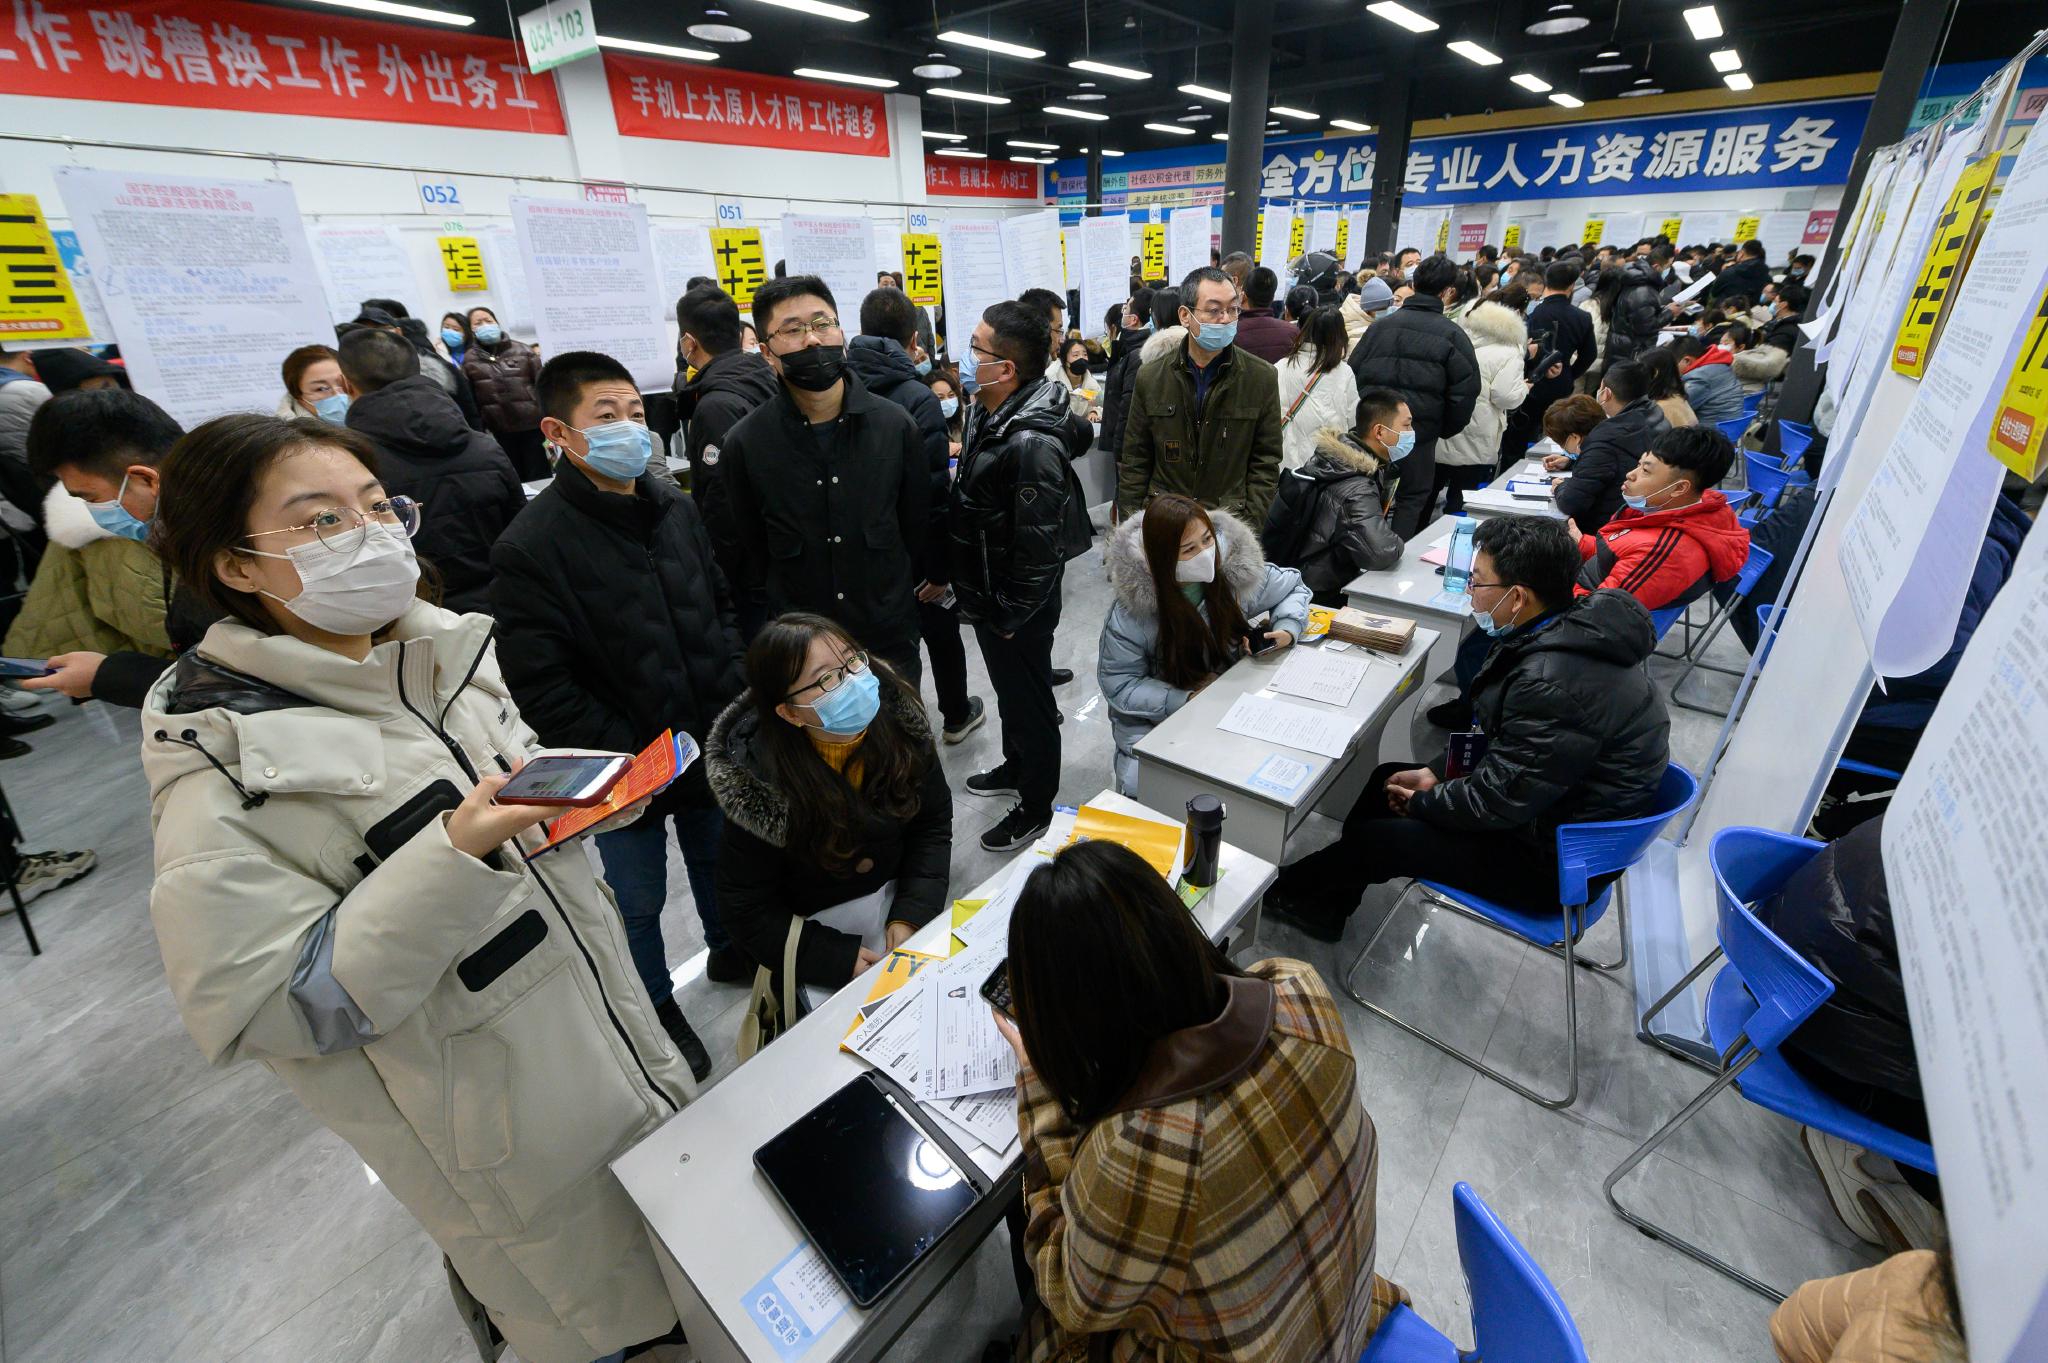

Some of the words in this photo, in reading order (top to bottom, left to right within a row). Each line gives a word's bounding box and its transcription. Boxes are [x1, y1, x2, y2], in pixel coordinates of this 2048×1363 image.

[529, 9, 585, 54] 054-103
[0, 0, 82, 73] 作
[88, 10, 366, 98] 跳槽换工作
[377, 43, 539, 110] 外出务工
[629, 76, 804, 132] 手机上太原人才网
[808, 100, 876, 140] 工作超多
[1260, 145, 1376, 197] 全方位
[1403, 116, 1839, 194] 专业人力资源服务
[1131, 170, 1191, 185] 社保公积金代理
[1195, 167, 1226, 180] 劳务外
[423, 185, 460, 203] 052
[719, 205, 743, 220] 051
[910, 214, 928, 227] 050
[443, 244, 478, 260] 十二
[717, 239, 761, 266] 十二
[905, 243, 937, 265] 十二
[722, 269, 764, 295] 十三
[907, 268, 938, 290] 十三
[855, 1016, 883, 1041] 个人简历
[924, 1068, 933, 1096] 个人简历
[758, 1294, 799, 1345] 温馨提示
